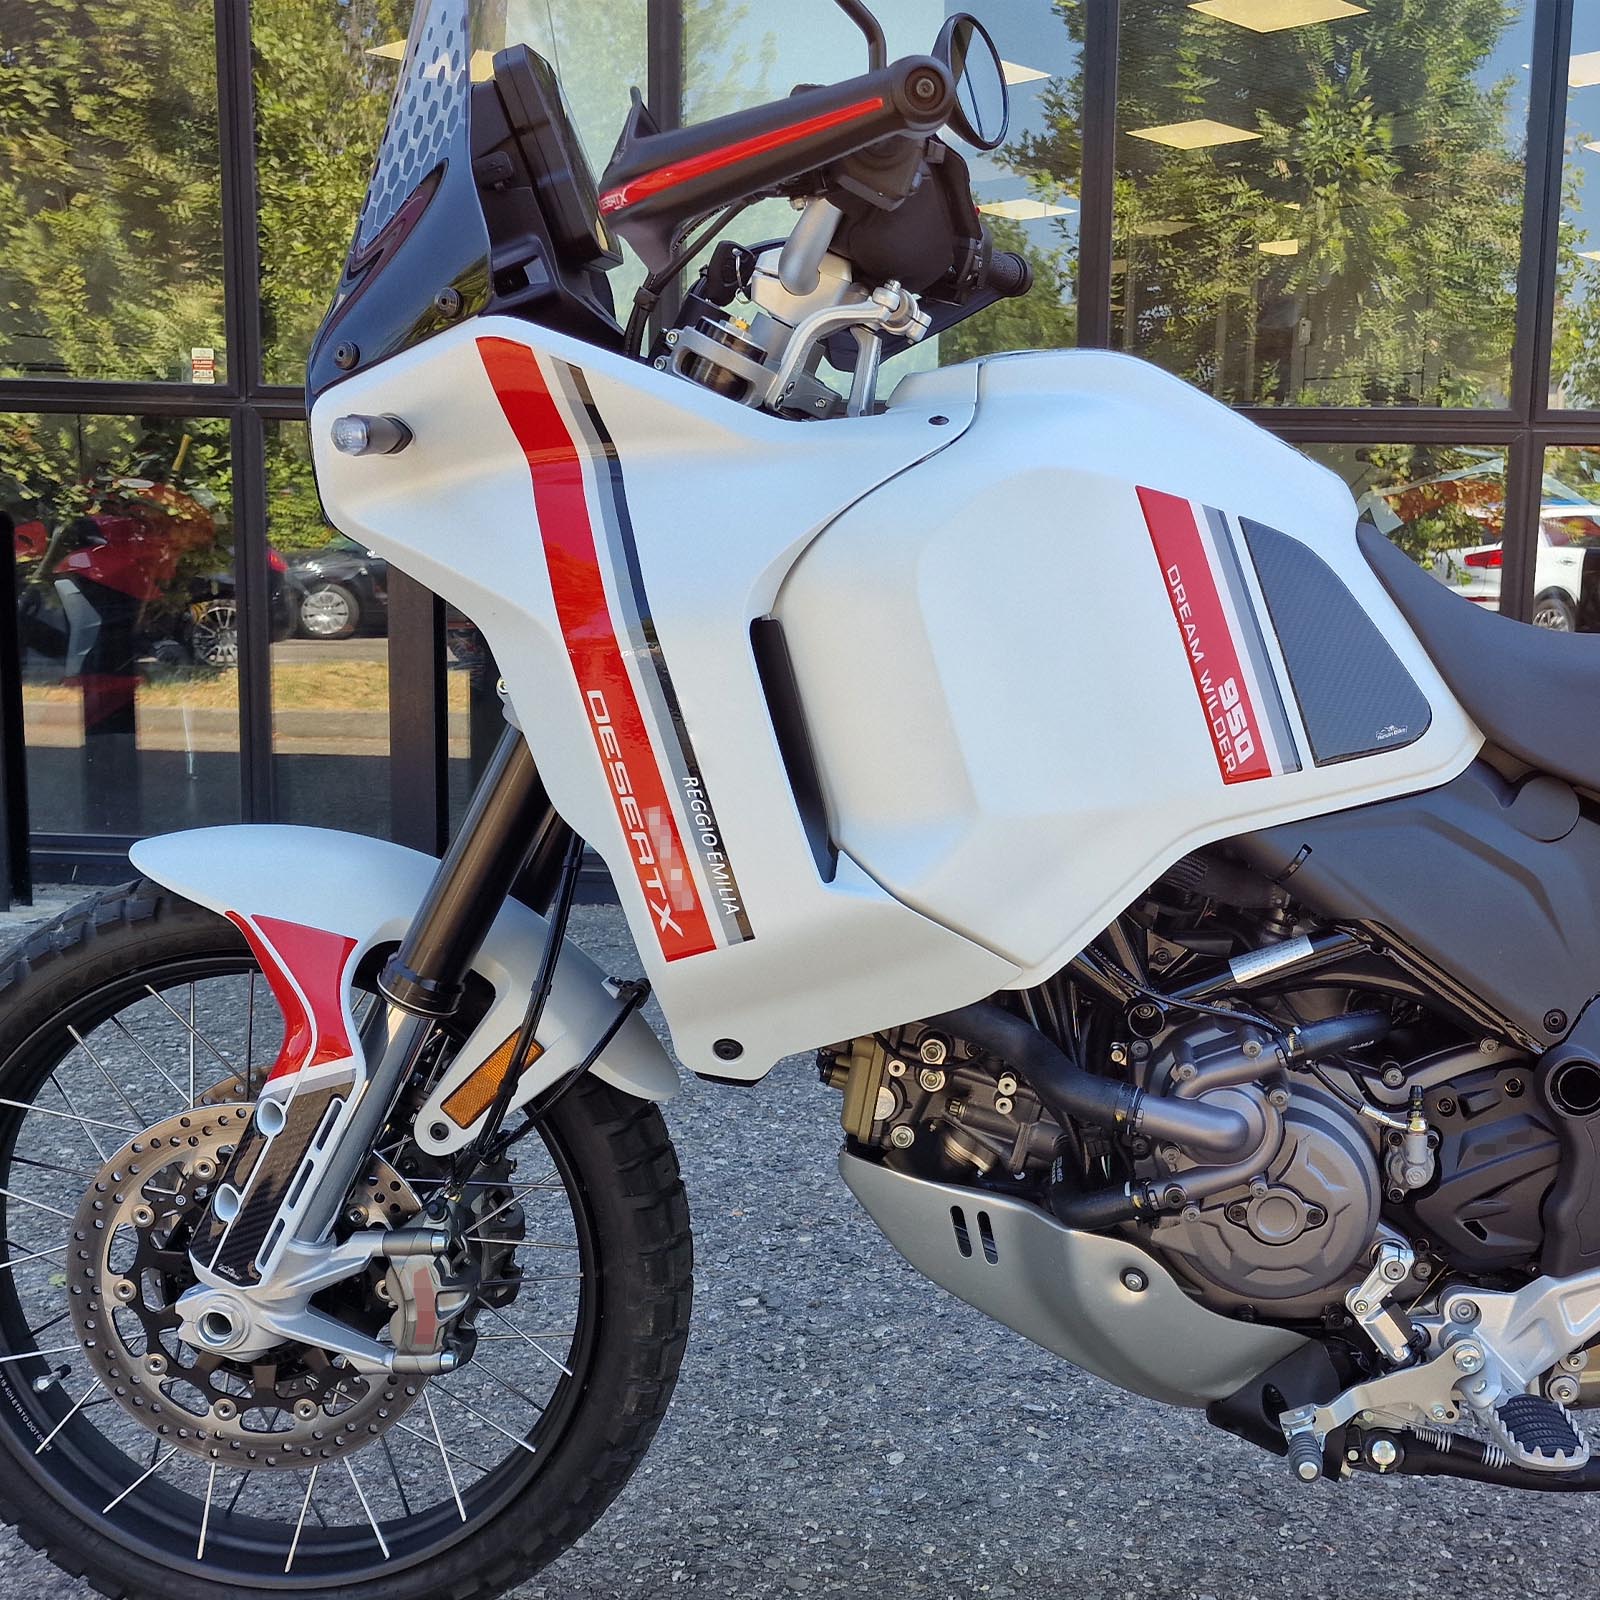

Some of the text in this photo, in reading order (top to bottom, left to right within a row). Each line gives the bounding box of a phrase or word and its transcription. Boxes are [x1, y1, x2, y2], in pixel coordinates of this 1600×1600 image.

[1167, 564, 1236, 773] DREAM WILDER
[1218, 677, 1254, 764] 950
[682, 777, 740, 915] REGGIO EMILIA
[27, 1421, 40, 1436] DOT
